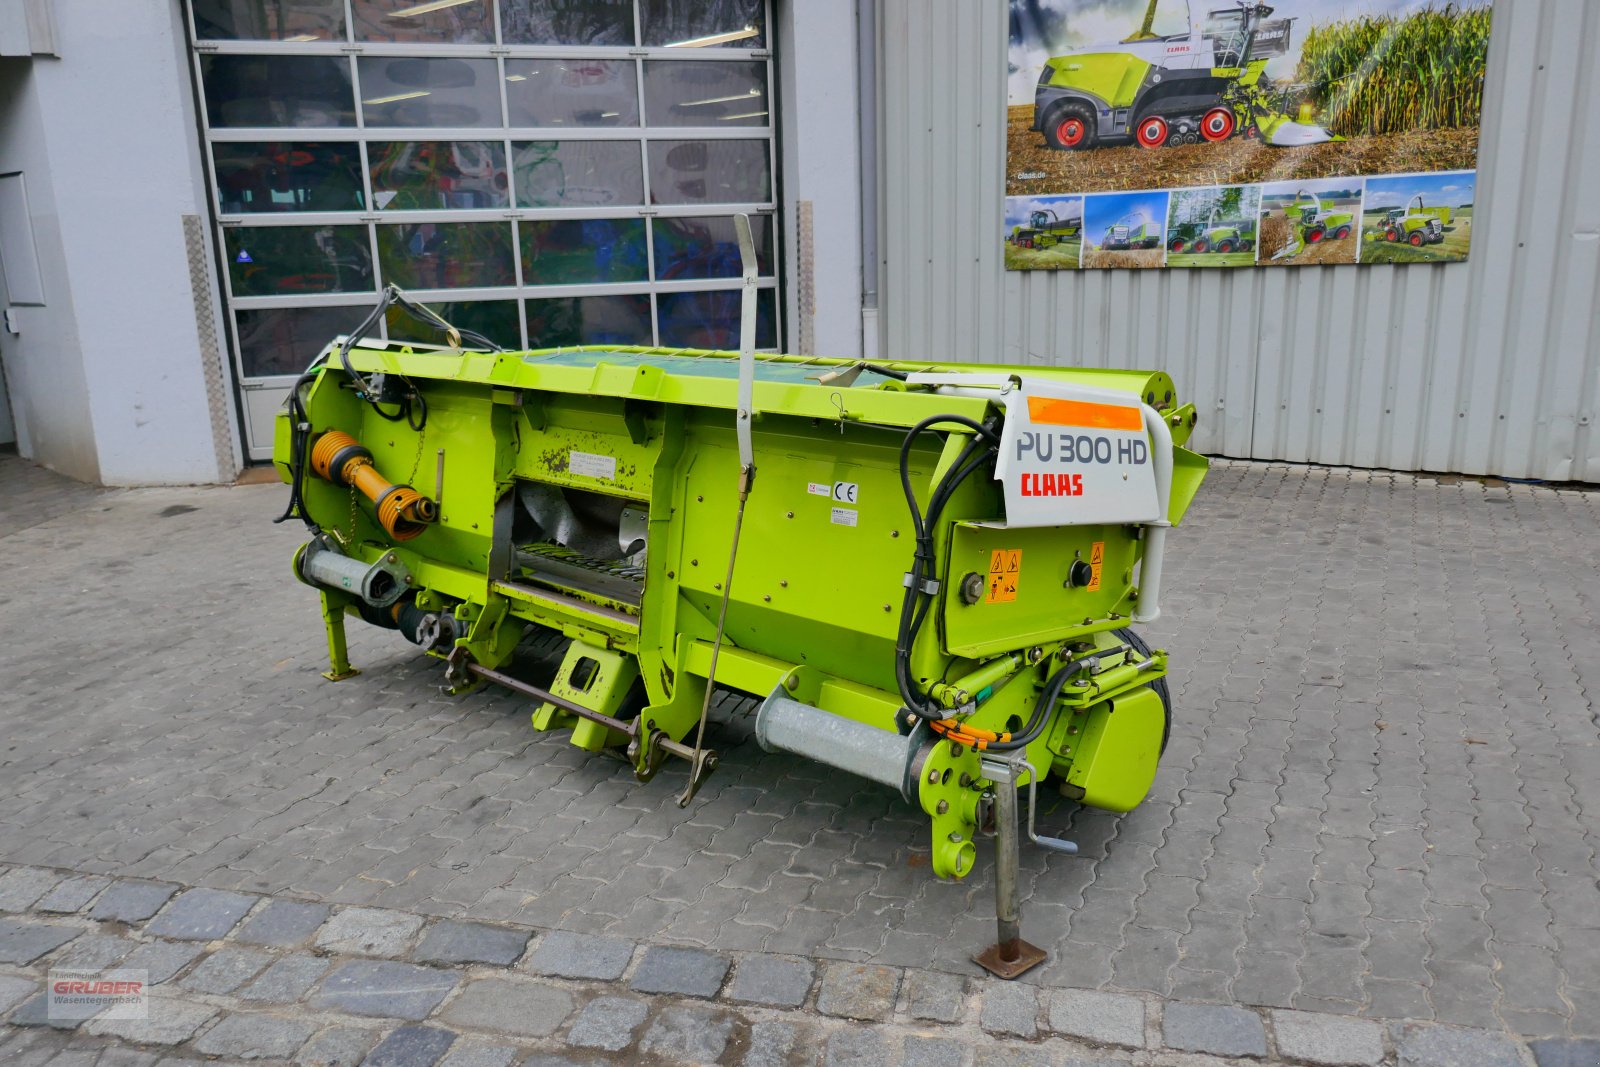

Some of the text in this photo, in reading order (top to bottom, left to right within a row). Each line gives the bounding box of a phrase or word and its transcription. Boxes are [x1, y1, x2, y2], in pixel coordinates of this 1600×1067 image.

[1167, 45, 1191, 53] CLAAS
[1017, 171, 1046, 180] claas.de
[1016, 431, 1147, 465] PU 300 HD
[834, 482, 856, 502] CE
[1020, 473, 1083, 497] CLAAS
